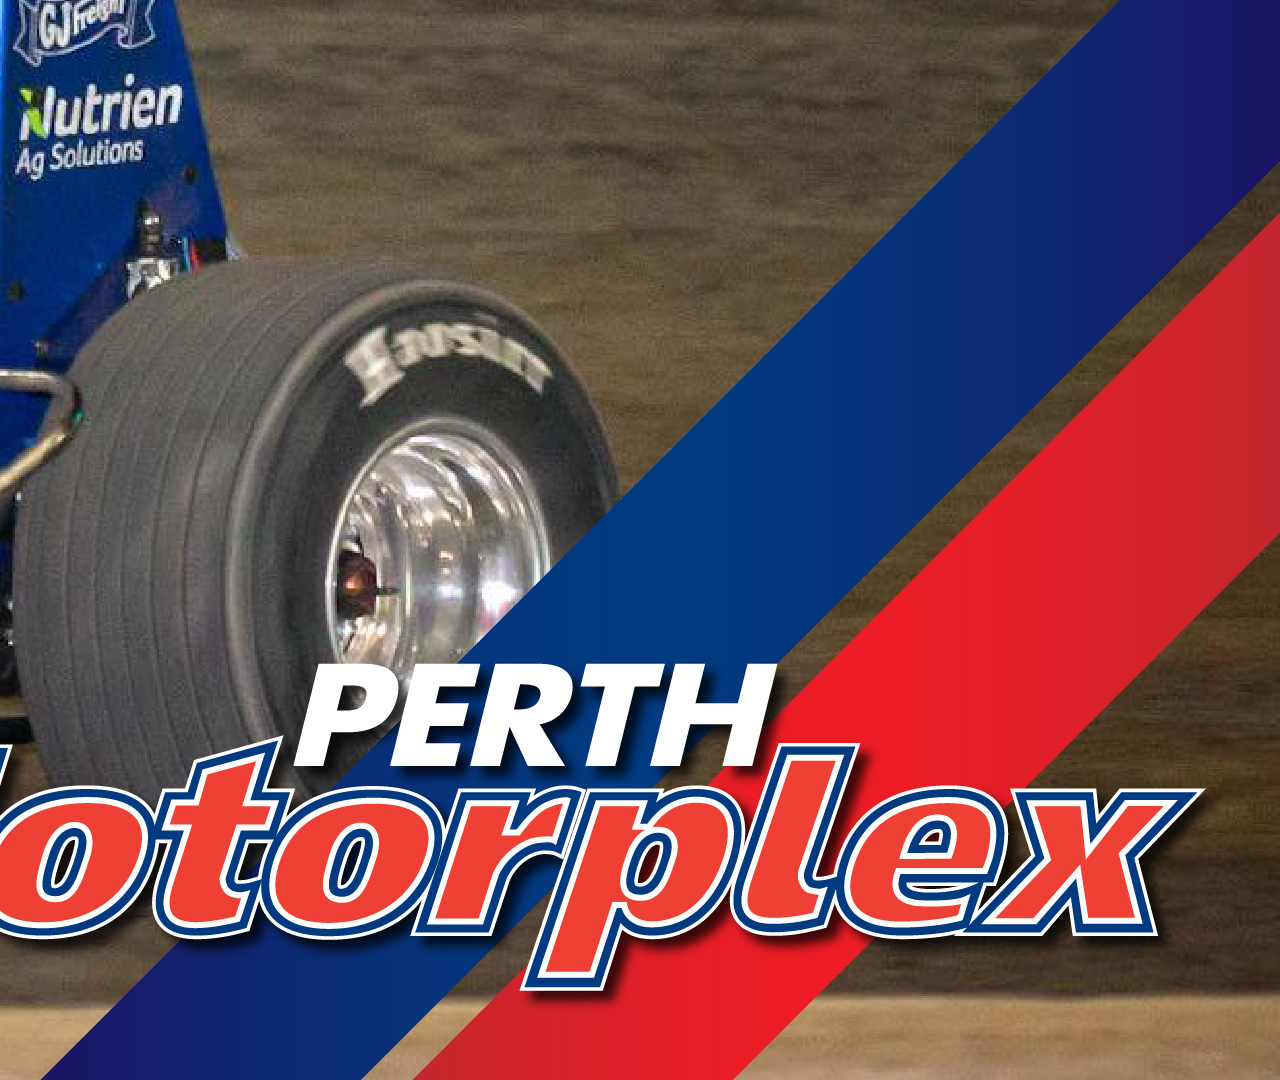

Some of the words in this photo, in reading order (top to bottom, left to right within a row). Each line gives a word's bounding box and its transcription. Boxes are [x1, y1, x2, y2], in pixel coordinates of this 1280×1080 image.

[19, 73, 183, 141] Nutrien
[15, 147, 45, 181] Ag
[50, 138, 144, 171] Solutions
